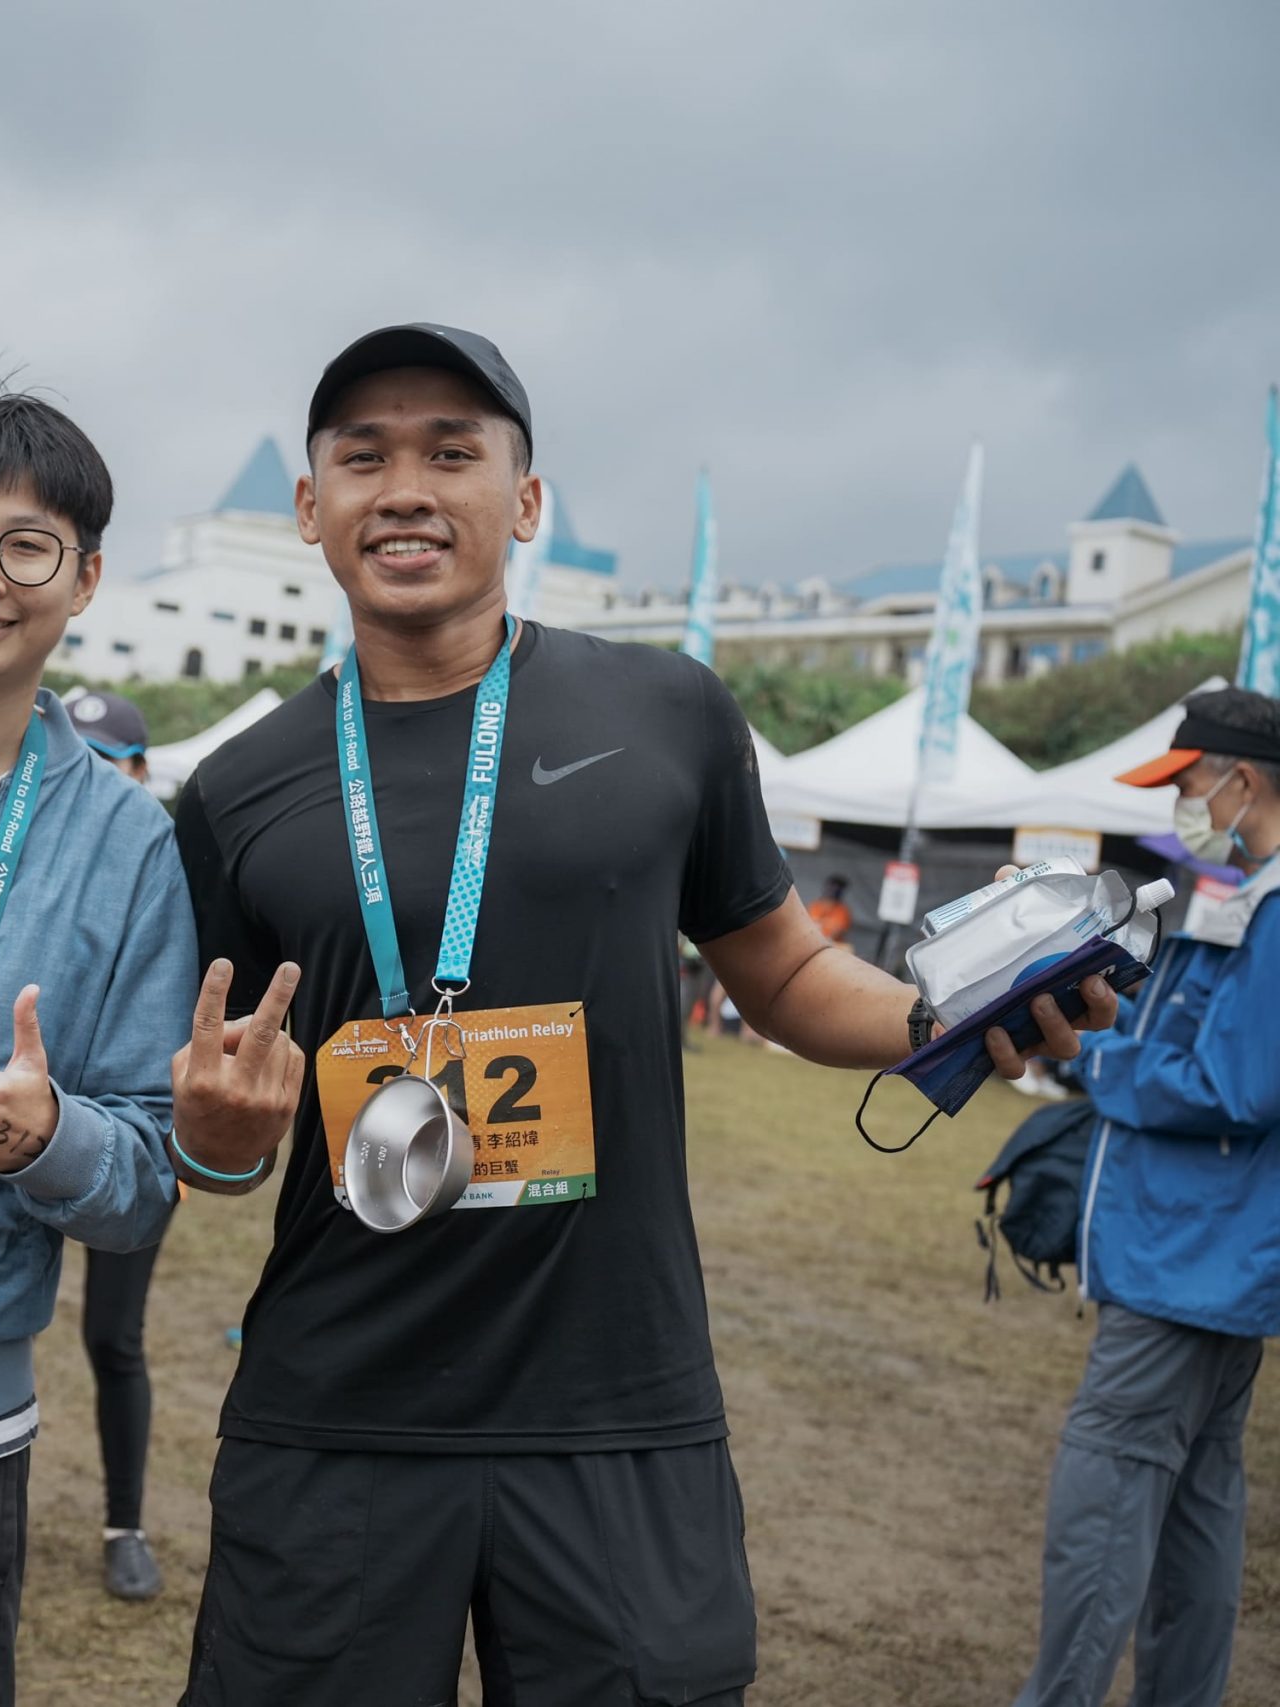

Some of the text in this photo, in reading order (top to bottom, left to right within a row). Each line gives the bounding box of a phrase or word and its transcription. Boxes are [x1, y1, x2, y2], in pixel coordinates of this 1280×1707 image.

[341, 681, 361, 772] Road to Off-Road
[472, 702, 502, 784] FULONG
[0, 752, 38, 854] Road to Off-Road
[476, 795, 490, 828] Xtrail
[348, 778, 384, 906] 公路越野鐵人三項
[363, 1044, 389, 1054] Xtrail
[461, 1020, 575, 1044] Triathlon Relay
[366, 1055, 542, 1126] 12
[469, 1191, 494, 1201] BANK
[528, 1180, 569, 1198] 混合組
